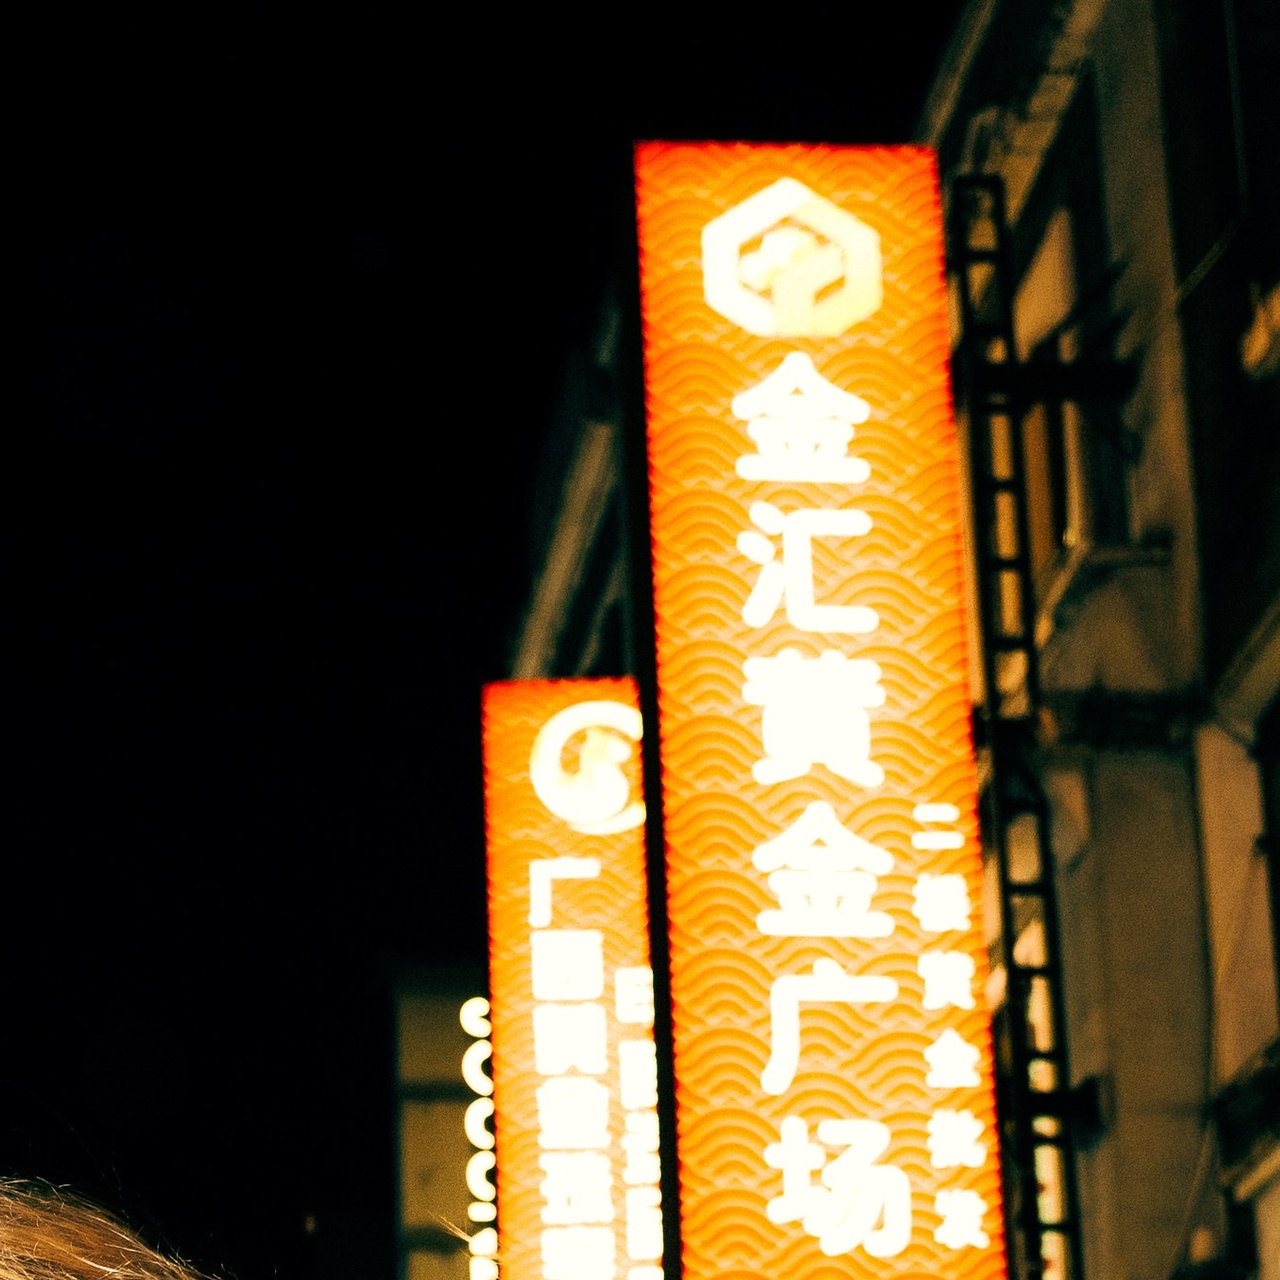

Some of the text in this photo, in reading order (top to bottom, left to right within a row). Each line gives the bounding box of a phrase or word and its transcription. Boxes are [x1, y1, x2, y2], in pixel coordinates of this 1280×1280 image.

[731, 350, 912, 1258] 金汇黄金广场
